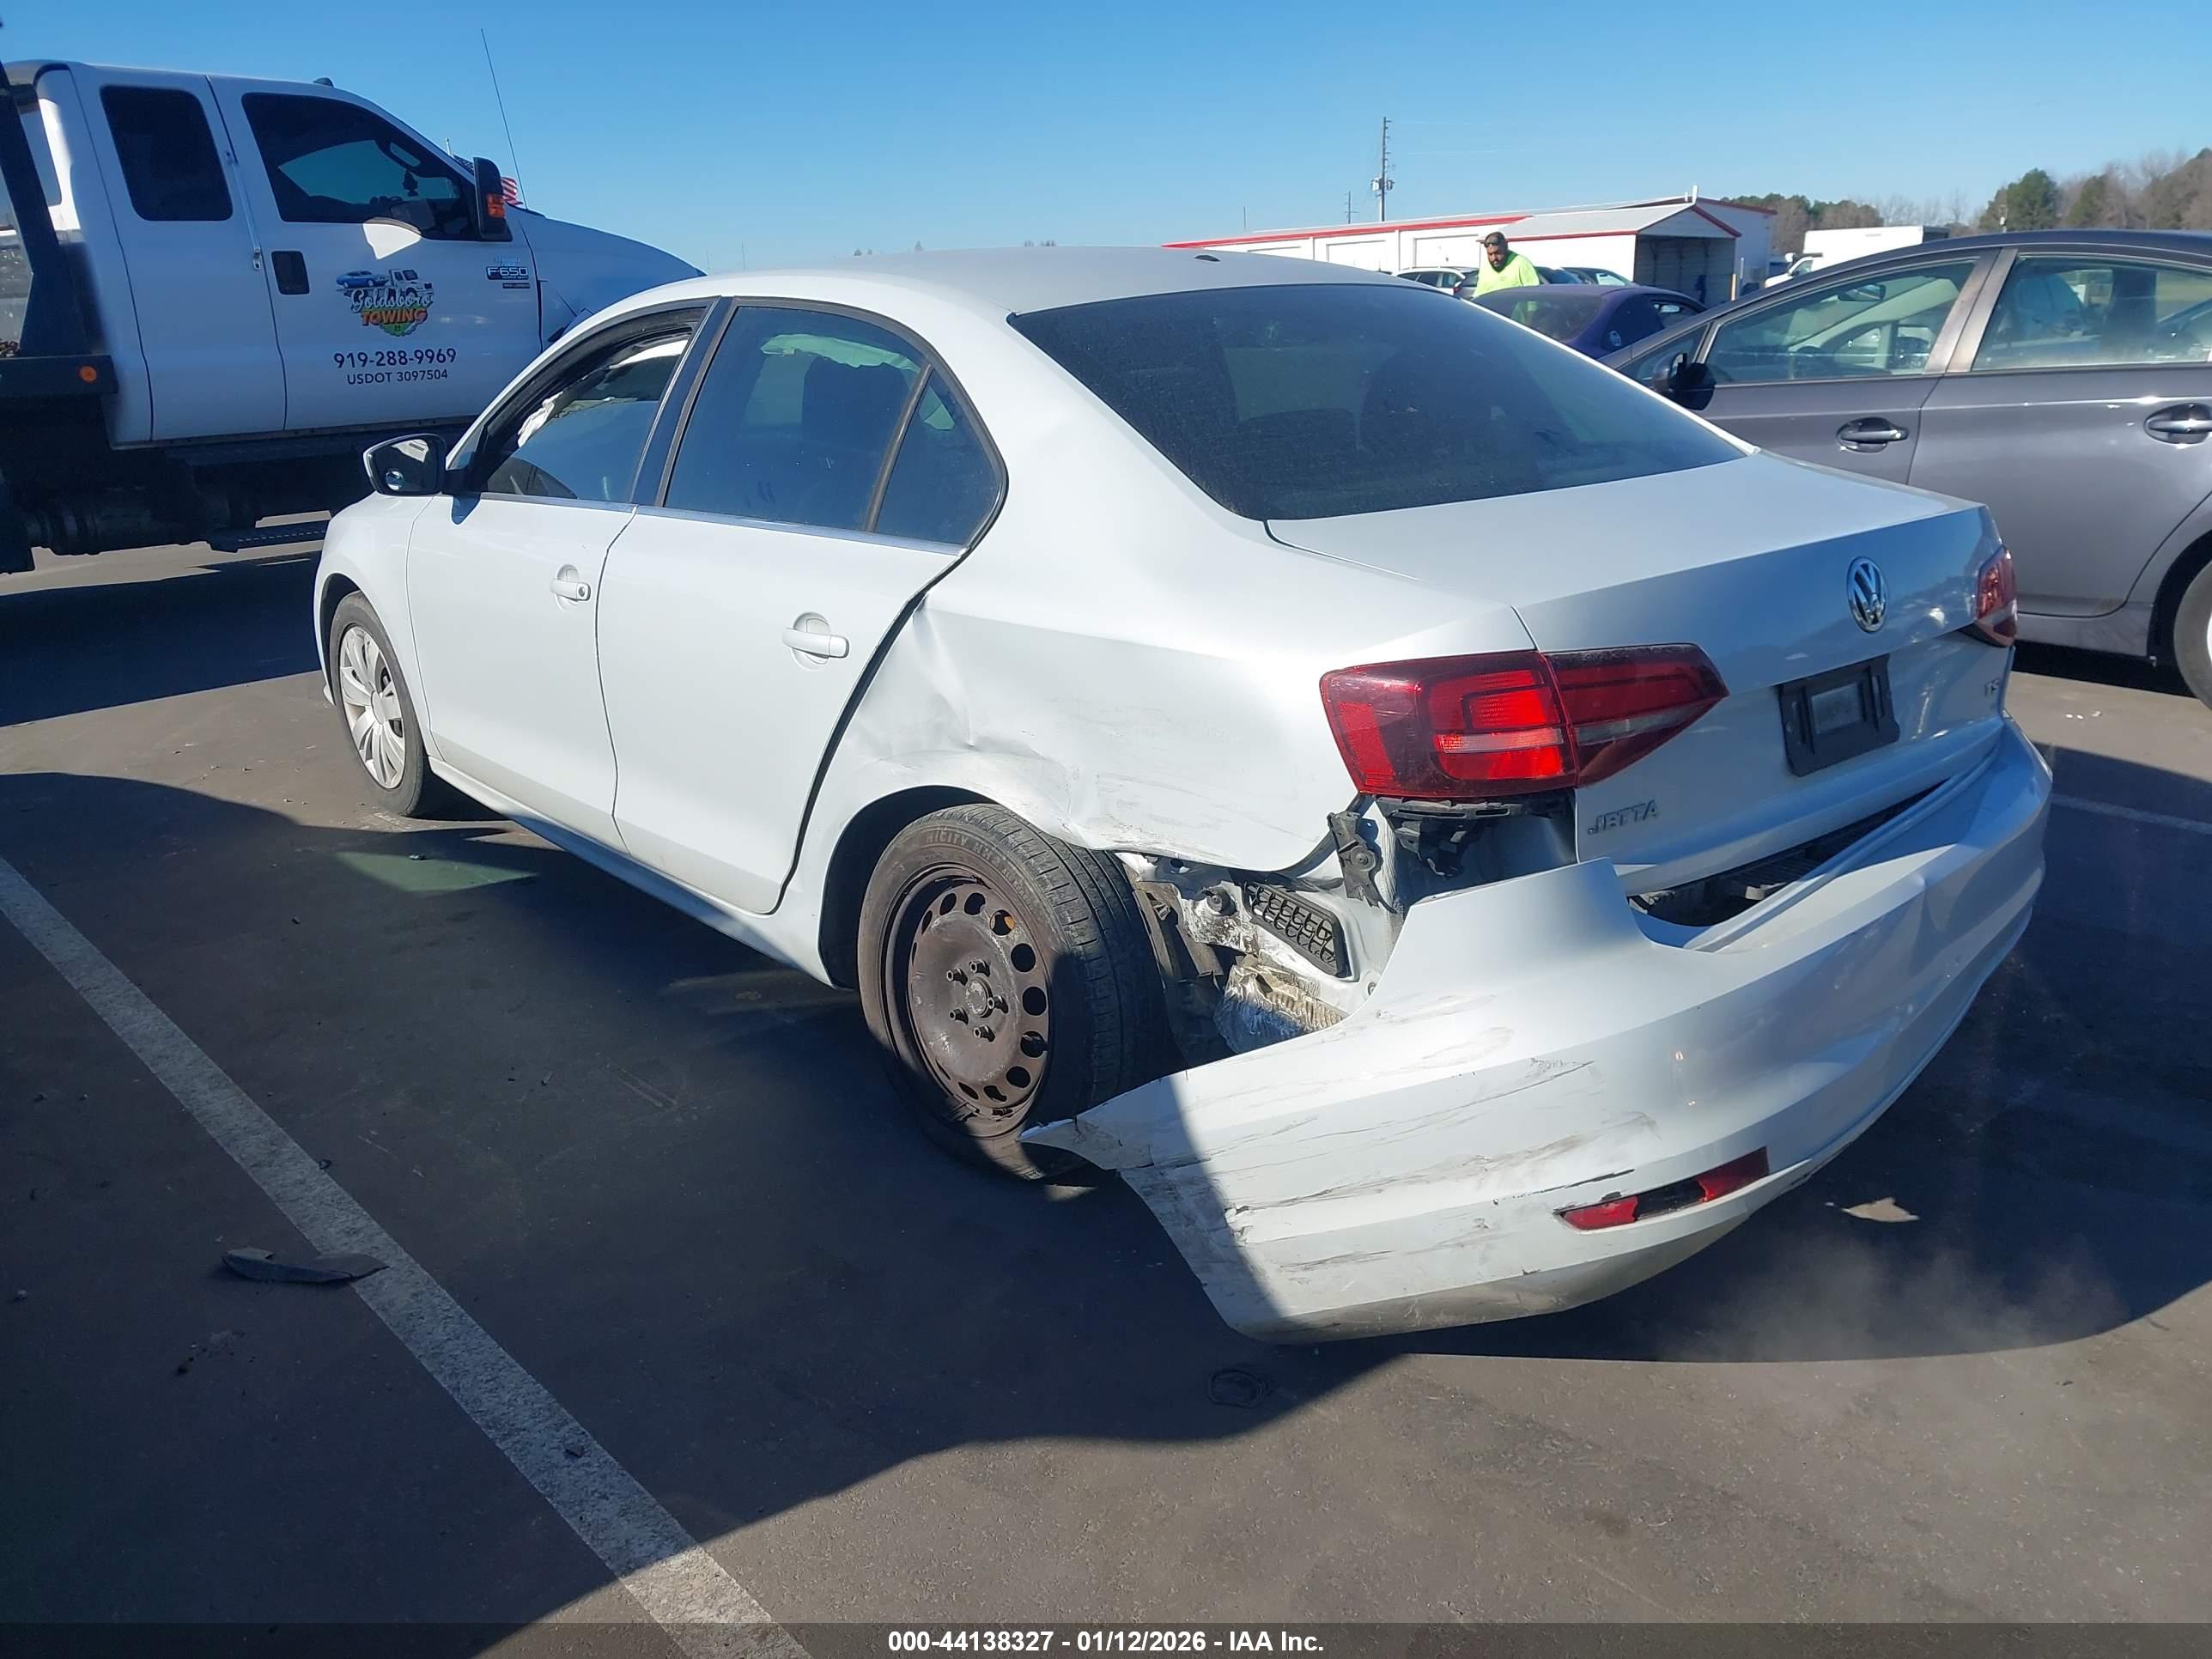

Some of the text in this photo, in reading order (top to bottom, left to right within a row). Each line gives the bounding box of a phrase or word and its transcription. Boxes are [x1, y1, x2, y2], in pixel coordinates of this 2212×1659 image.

[350, 288, 434, 313] Goldsboro
[362, 307, 428, 326] TOWING
[333, 347, 457, 368] 919-288-9969
[347, 368, 448, 385] USDOT 3097504
[1587, 799, 1659, 836] JETTA
